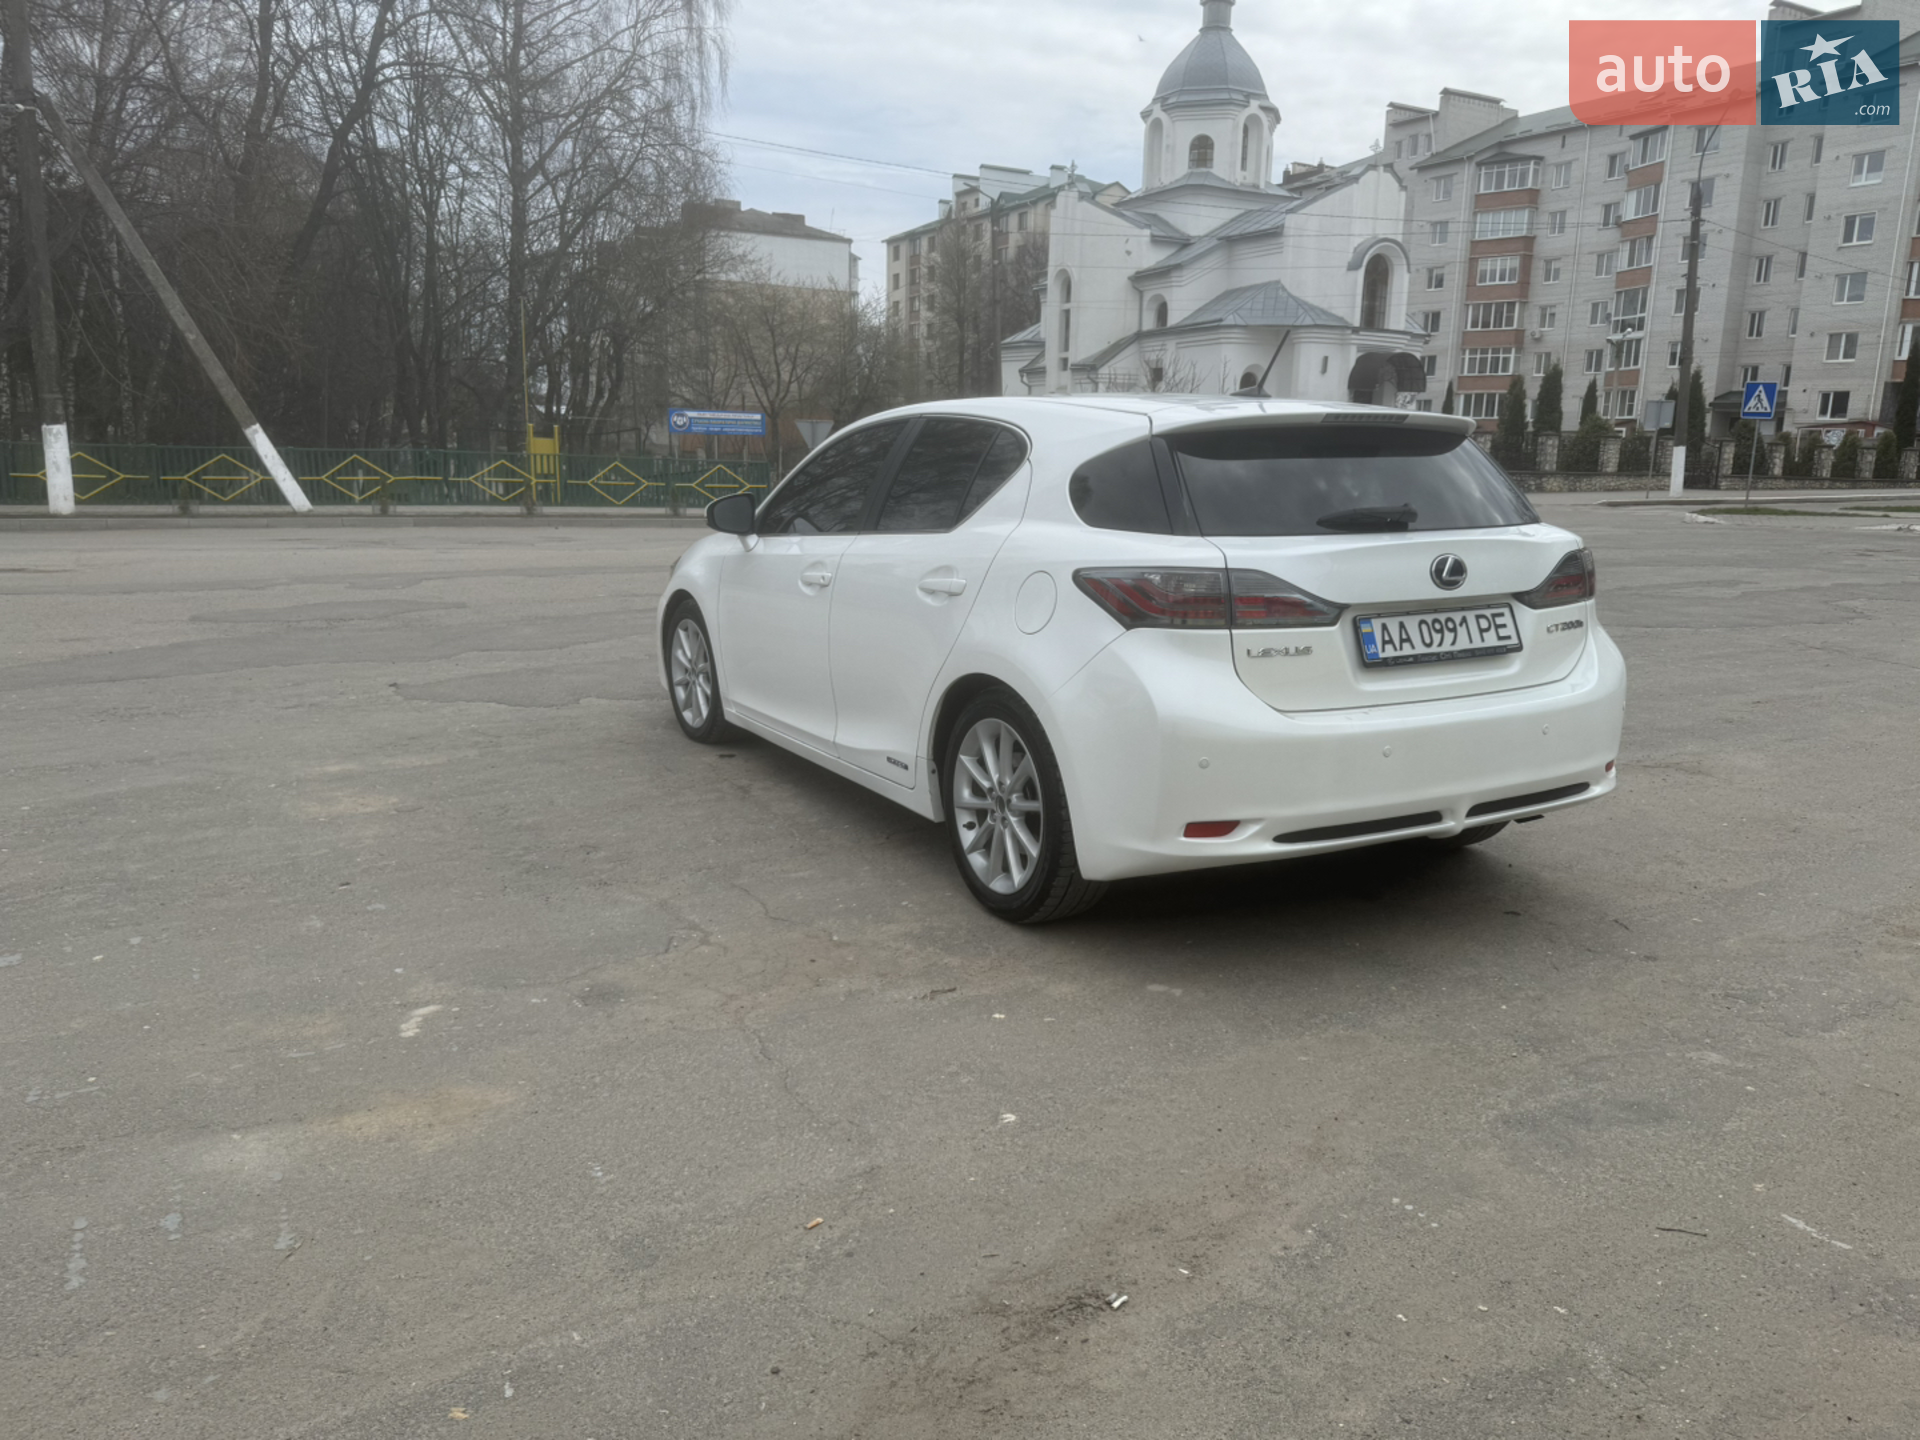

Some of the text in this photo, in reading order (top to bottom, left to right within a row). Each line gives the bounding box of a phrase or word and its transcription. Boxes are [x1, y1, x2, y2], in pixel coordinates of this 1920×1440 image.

[1381, 612, 1512, 653] AA 0991 PE
[1246, 645, 1313, 658] LEXUS
[1364, 644, 1379, 654] UA
